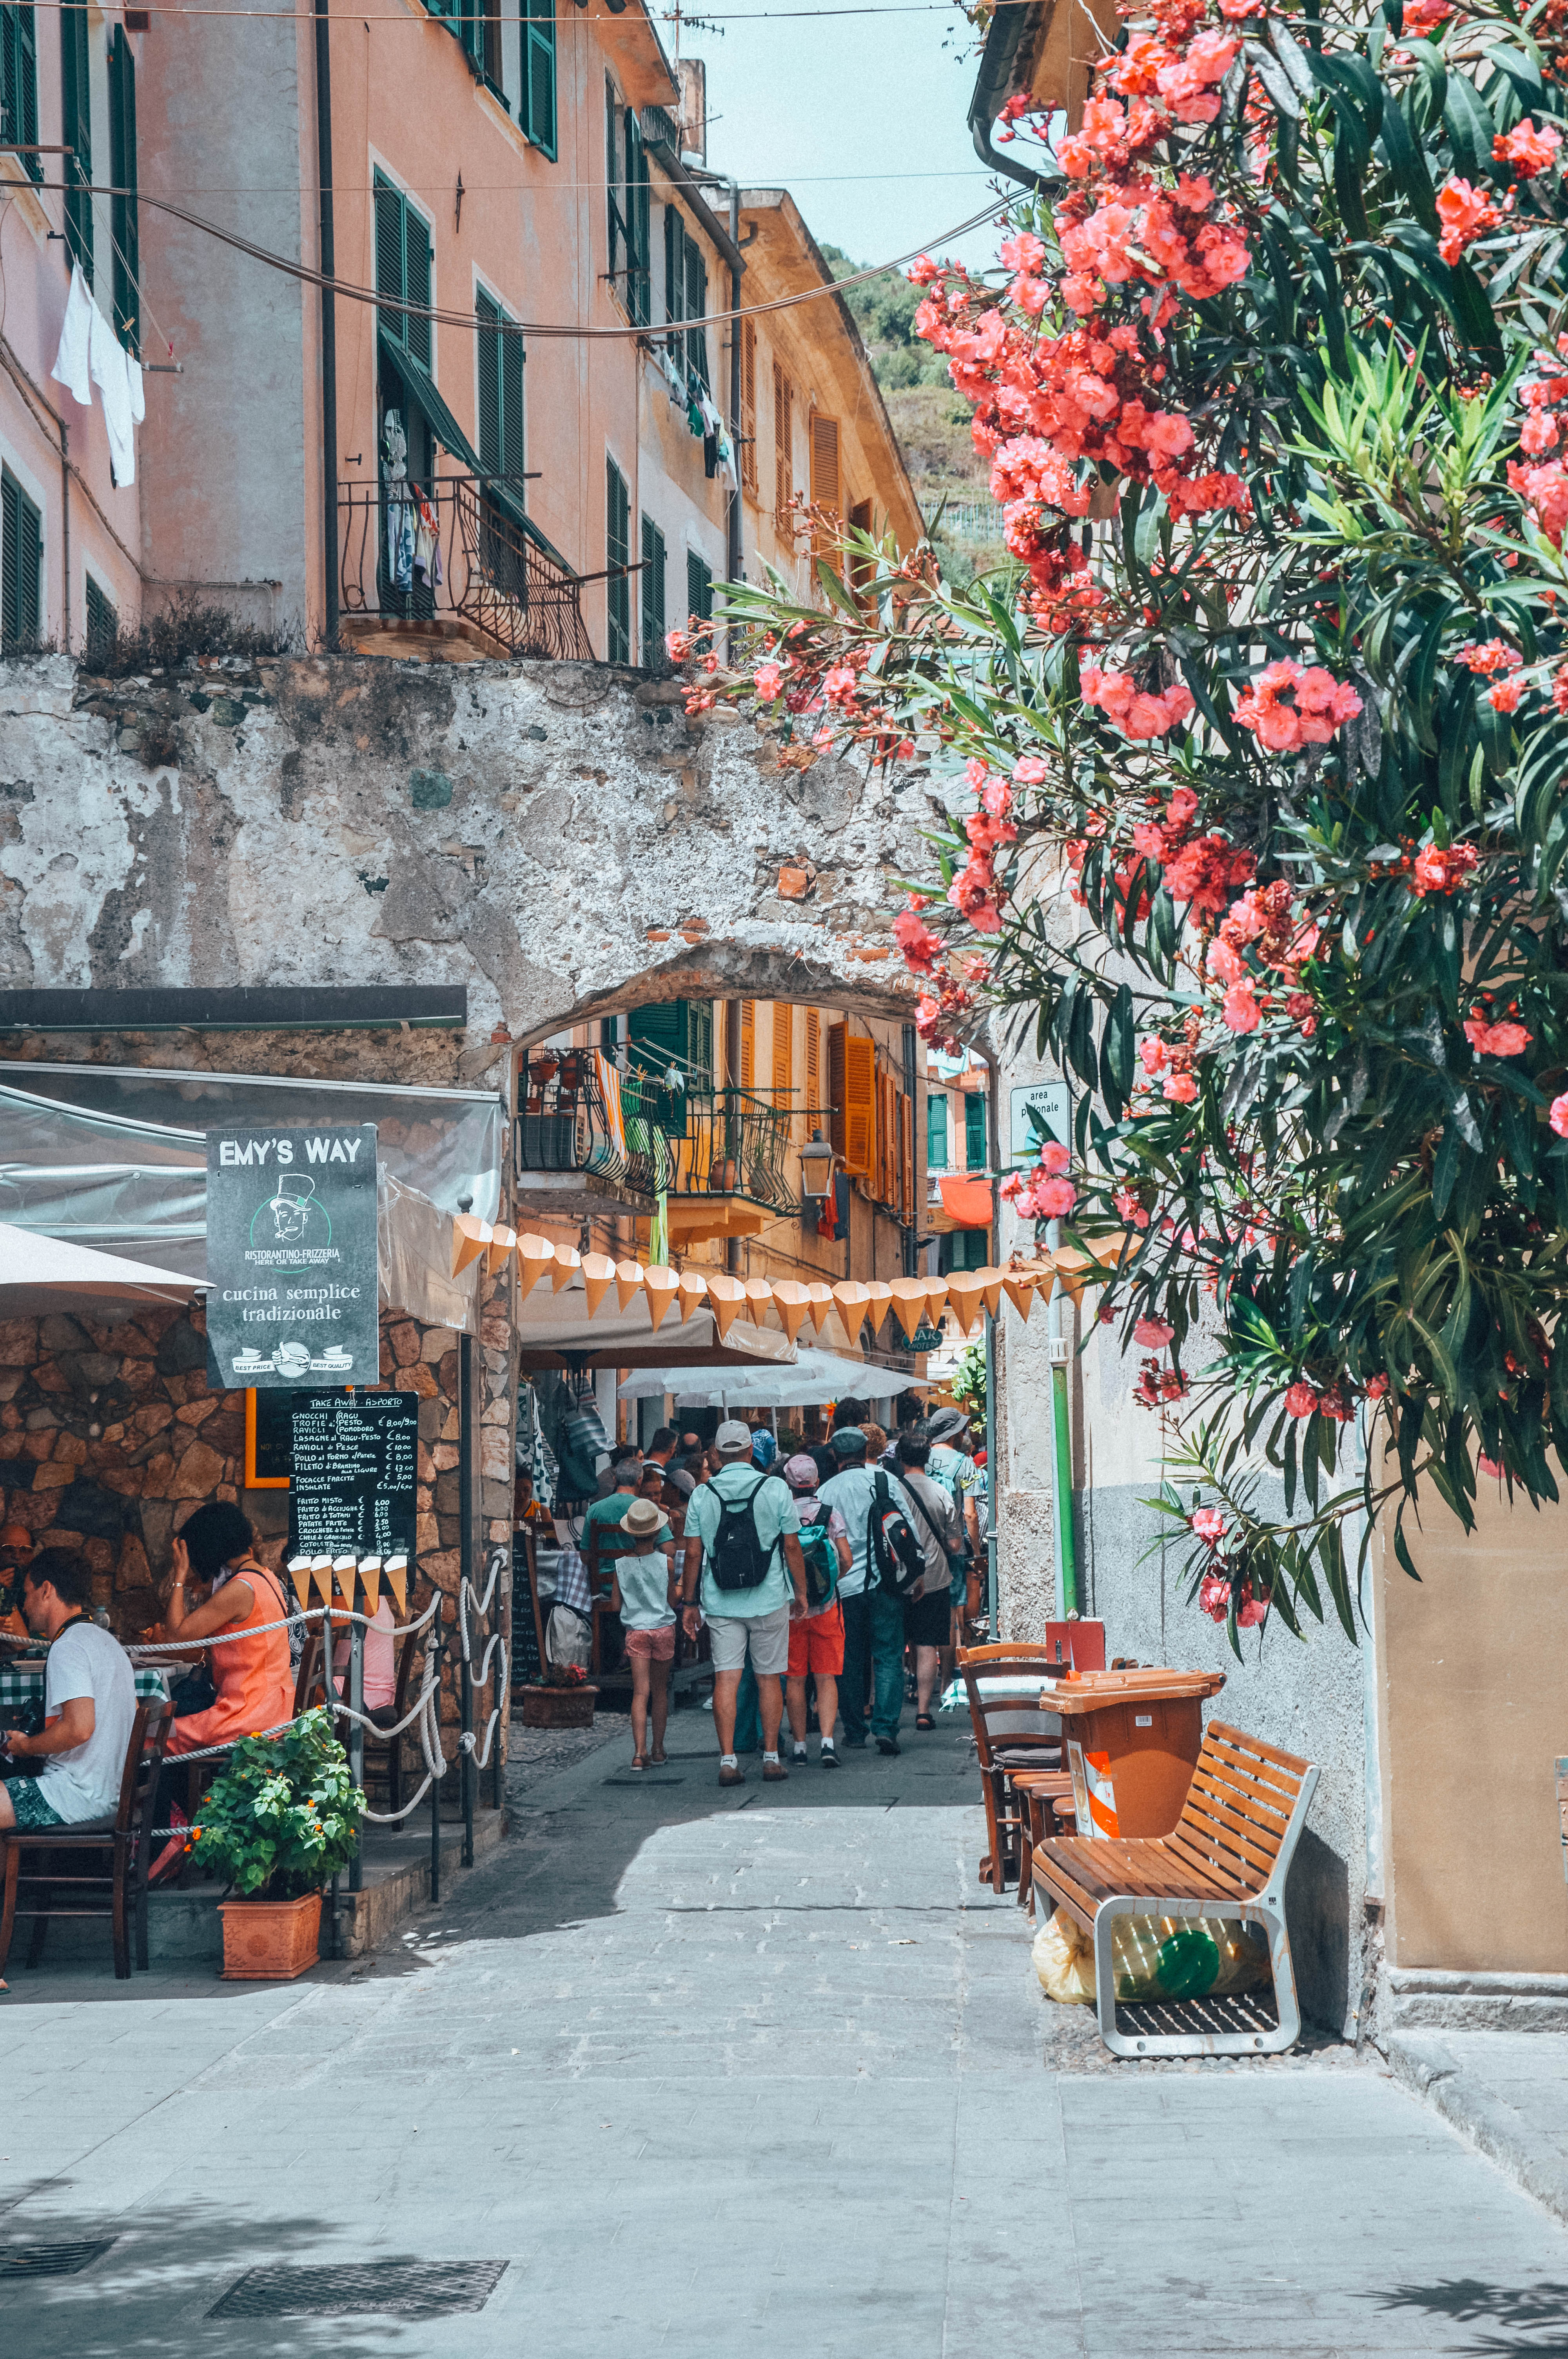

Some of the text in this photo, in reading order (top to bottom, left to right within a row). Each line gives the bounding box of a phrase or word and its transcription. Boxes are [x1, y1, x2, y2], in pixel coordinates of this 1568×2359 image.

[1031, 1091, 1048, 1100] area
[1022, 1102, 1058, 1118] ponale
[220, 1137, 361, 1166] EMY'S WAY
[245, 1248, 340, 1260] RISTORANTINO-FRIZZERIA
[222, 1283, 360, 1304] cucina semplice
[242, 1304, 341, 1321] tradizionale
[908, 1341, 938, 1350] ENOTECA
[310, 1399, 332, 1407] TAKE
[335, 1398, 358, 1407] AWAY
[366, 1398, 402, 1406] ASPORTO
